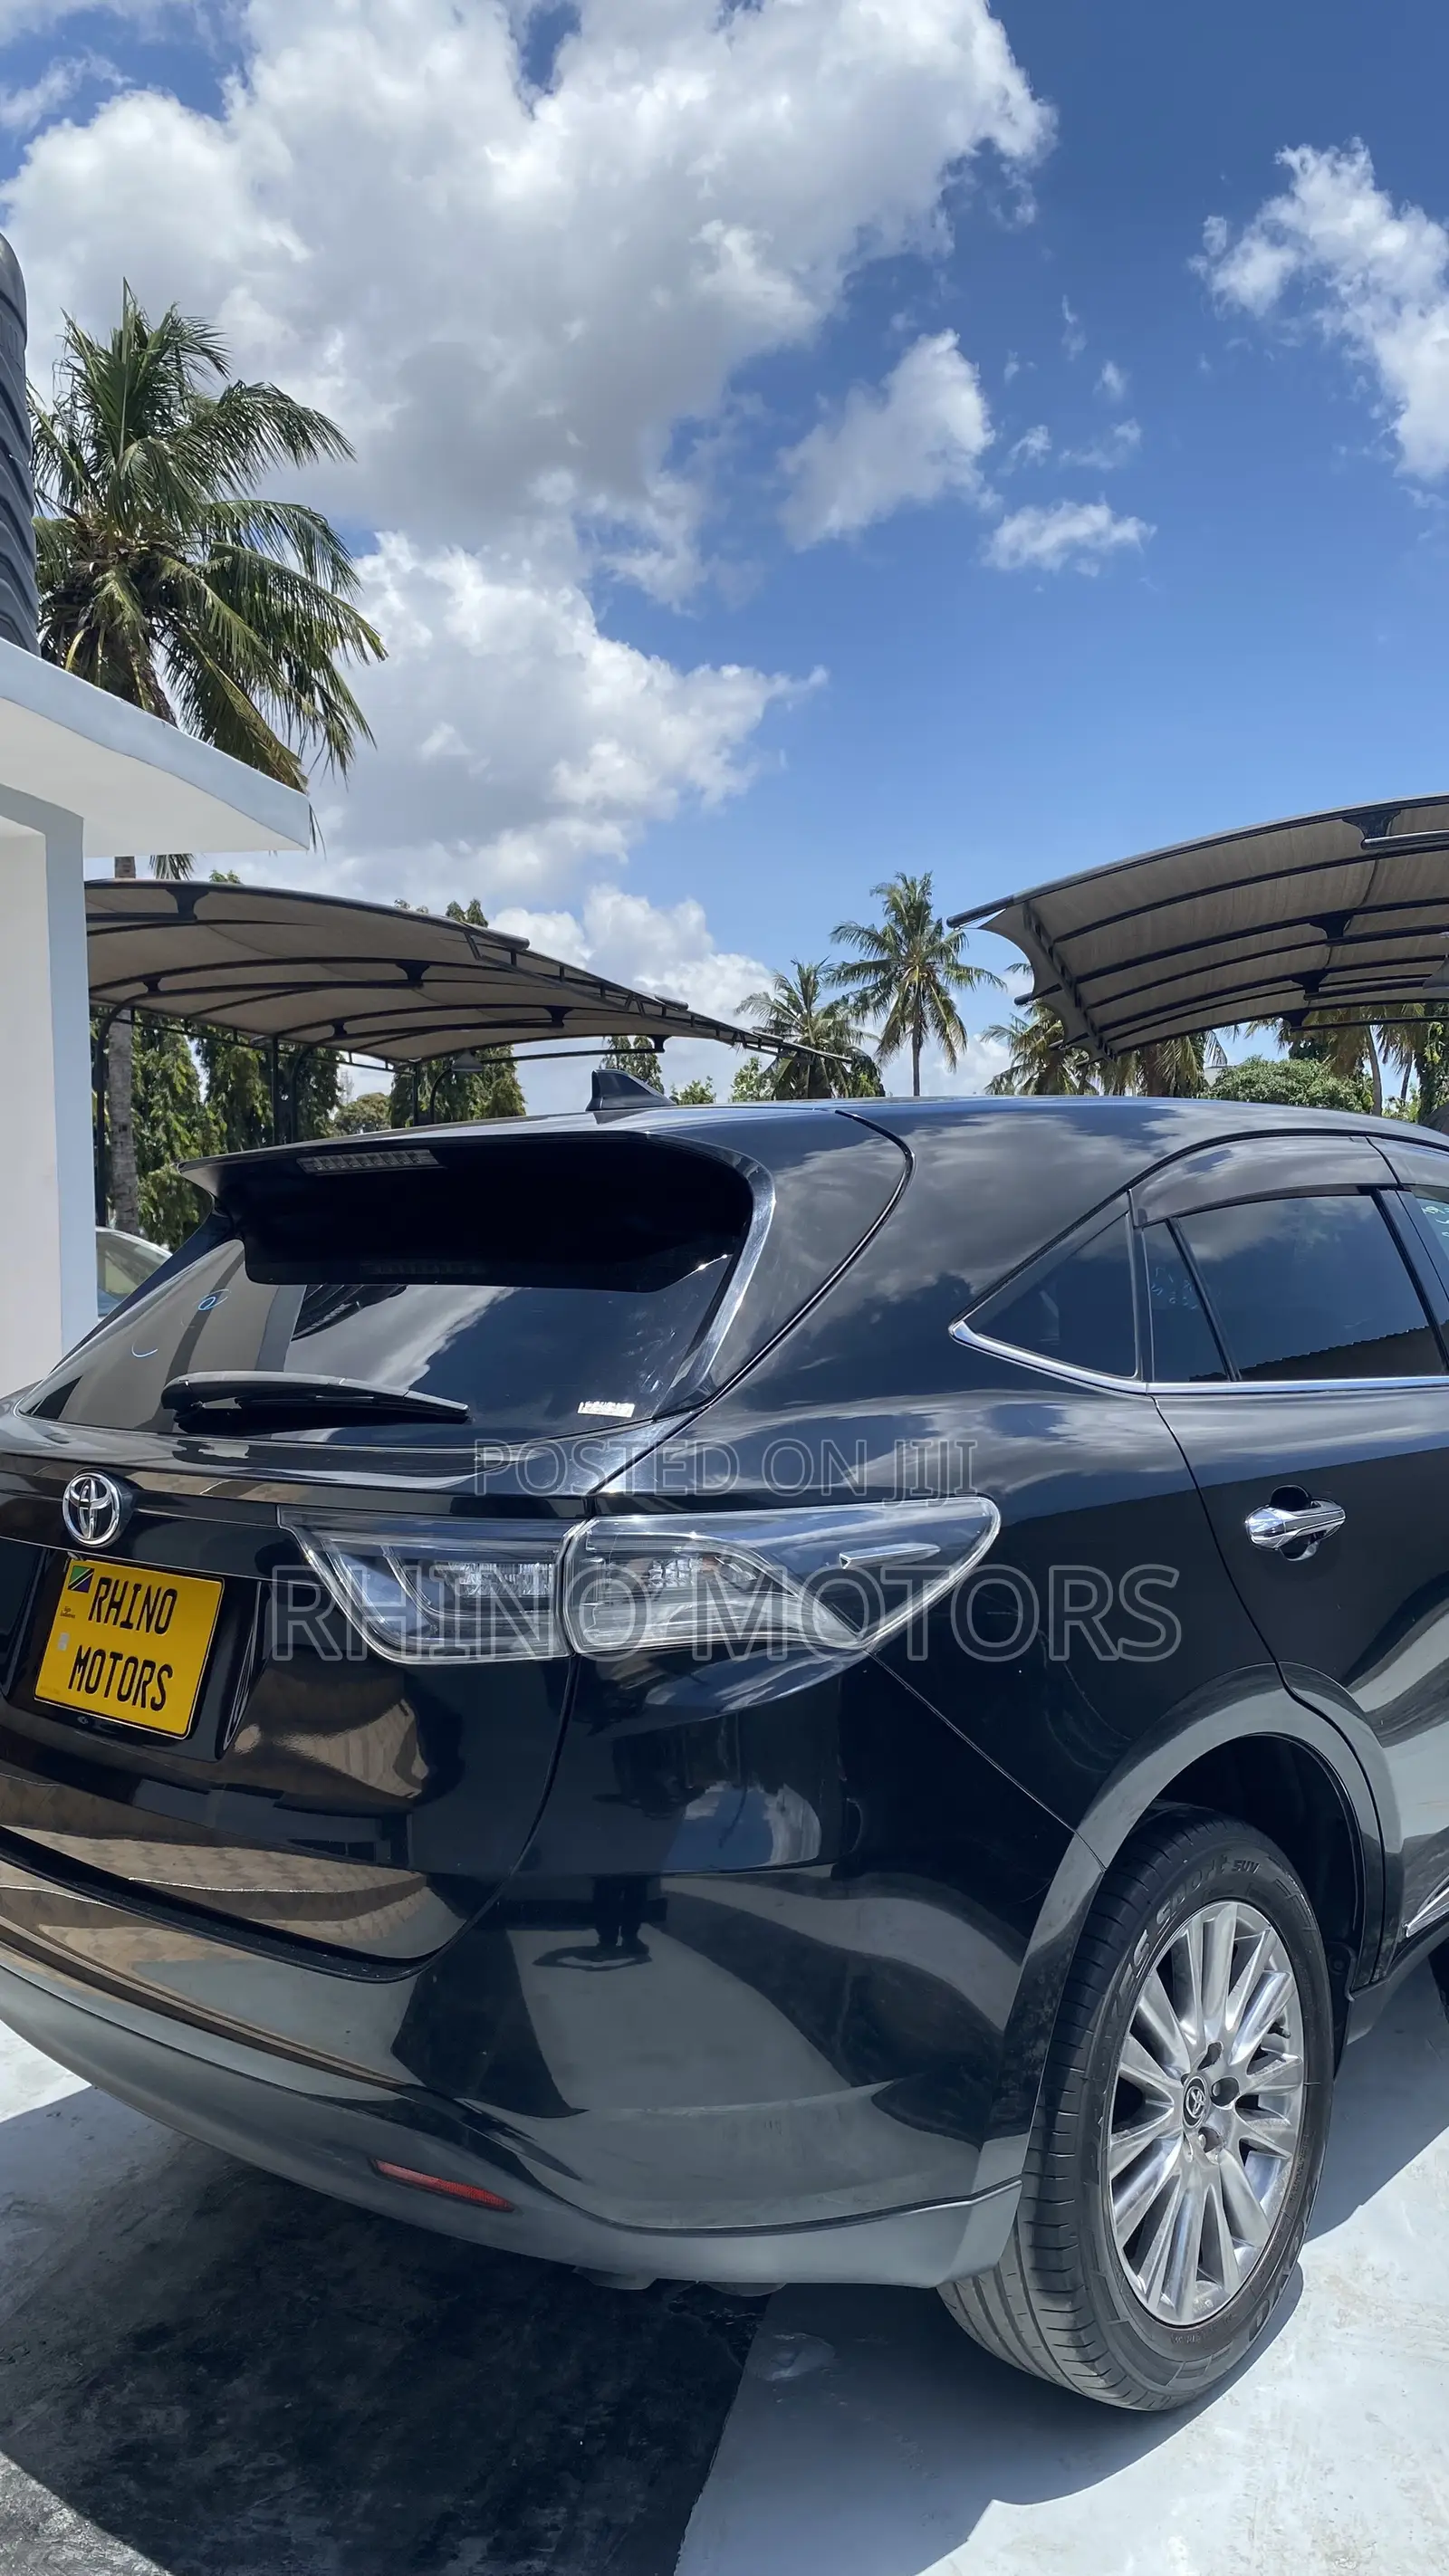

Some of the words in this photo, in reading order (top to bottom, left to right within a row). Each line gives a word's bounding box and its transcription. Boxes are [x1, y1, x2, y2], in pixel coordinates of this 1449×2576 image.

[88, 1576, 178, 1635] RHINO
[68, 1644, 173, 1712] MOTORS
[1231, 1859, 1262, 1874] SUV
